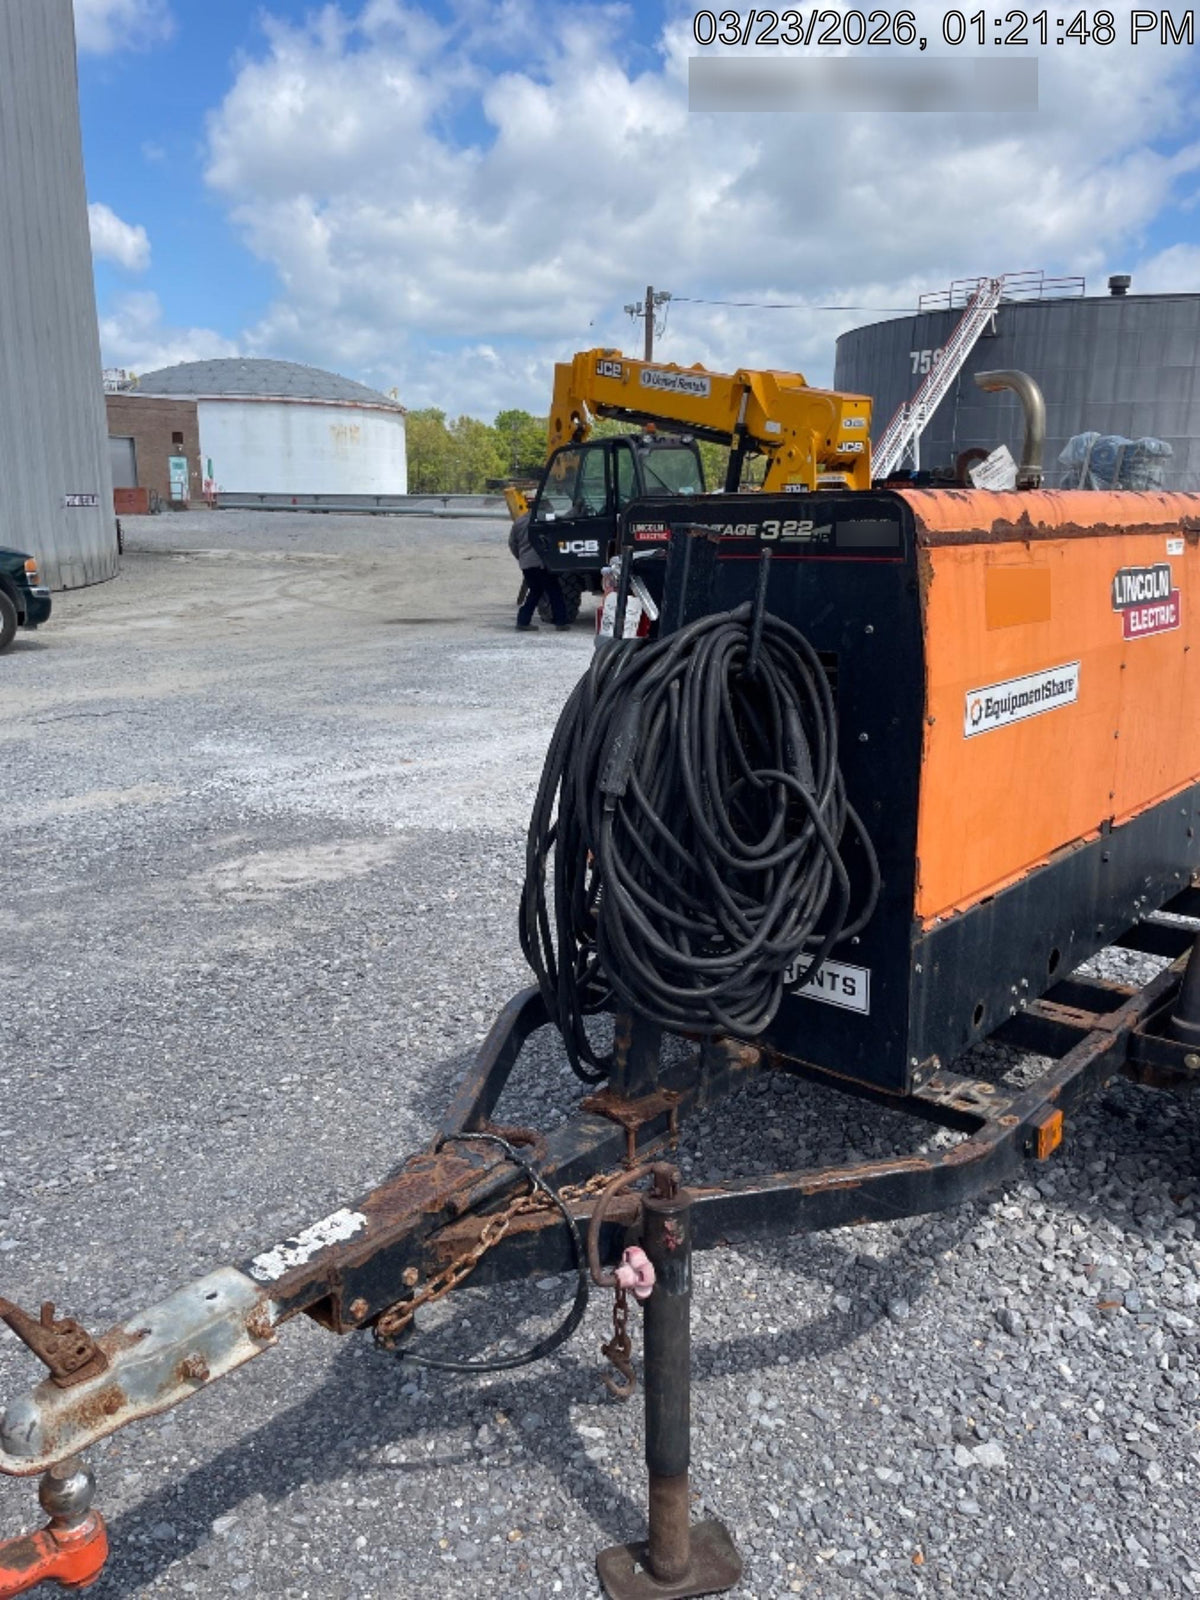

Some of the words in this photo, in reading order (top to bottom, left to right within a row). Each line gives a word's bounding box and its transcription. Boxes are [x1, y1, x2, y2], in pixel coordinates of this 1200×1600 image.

[597, 360, 622, 378] JCB
[652, 373, 679, 389] United
[678, 377, 707, 393] Rentals
[836, 441, 864, 453] JCB
[632, 523, 665, 533] LINCOLN
[639, 532, 668, 540] ELECTRIC
[760, 520, 814, 540] 322
[558, 540, 599, 553] JCB
[1114, 570, 1169, 604] LINCOLN
[1130, 603, 1176, 632] ELECTRIC
[984, 678, 1075, 720] EquipmentShare
